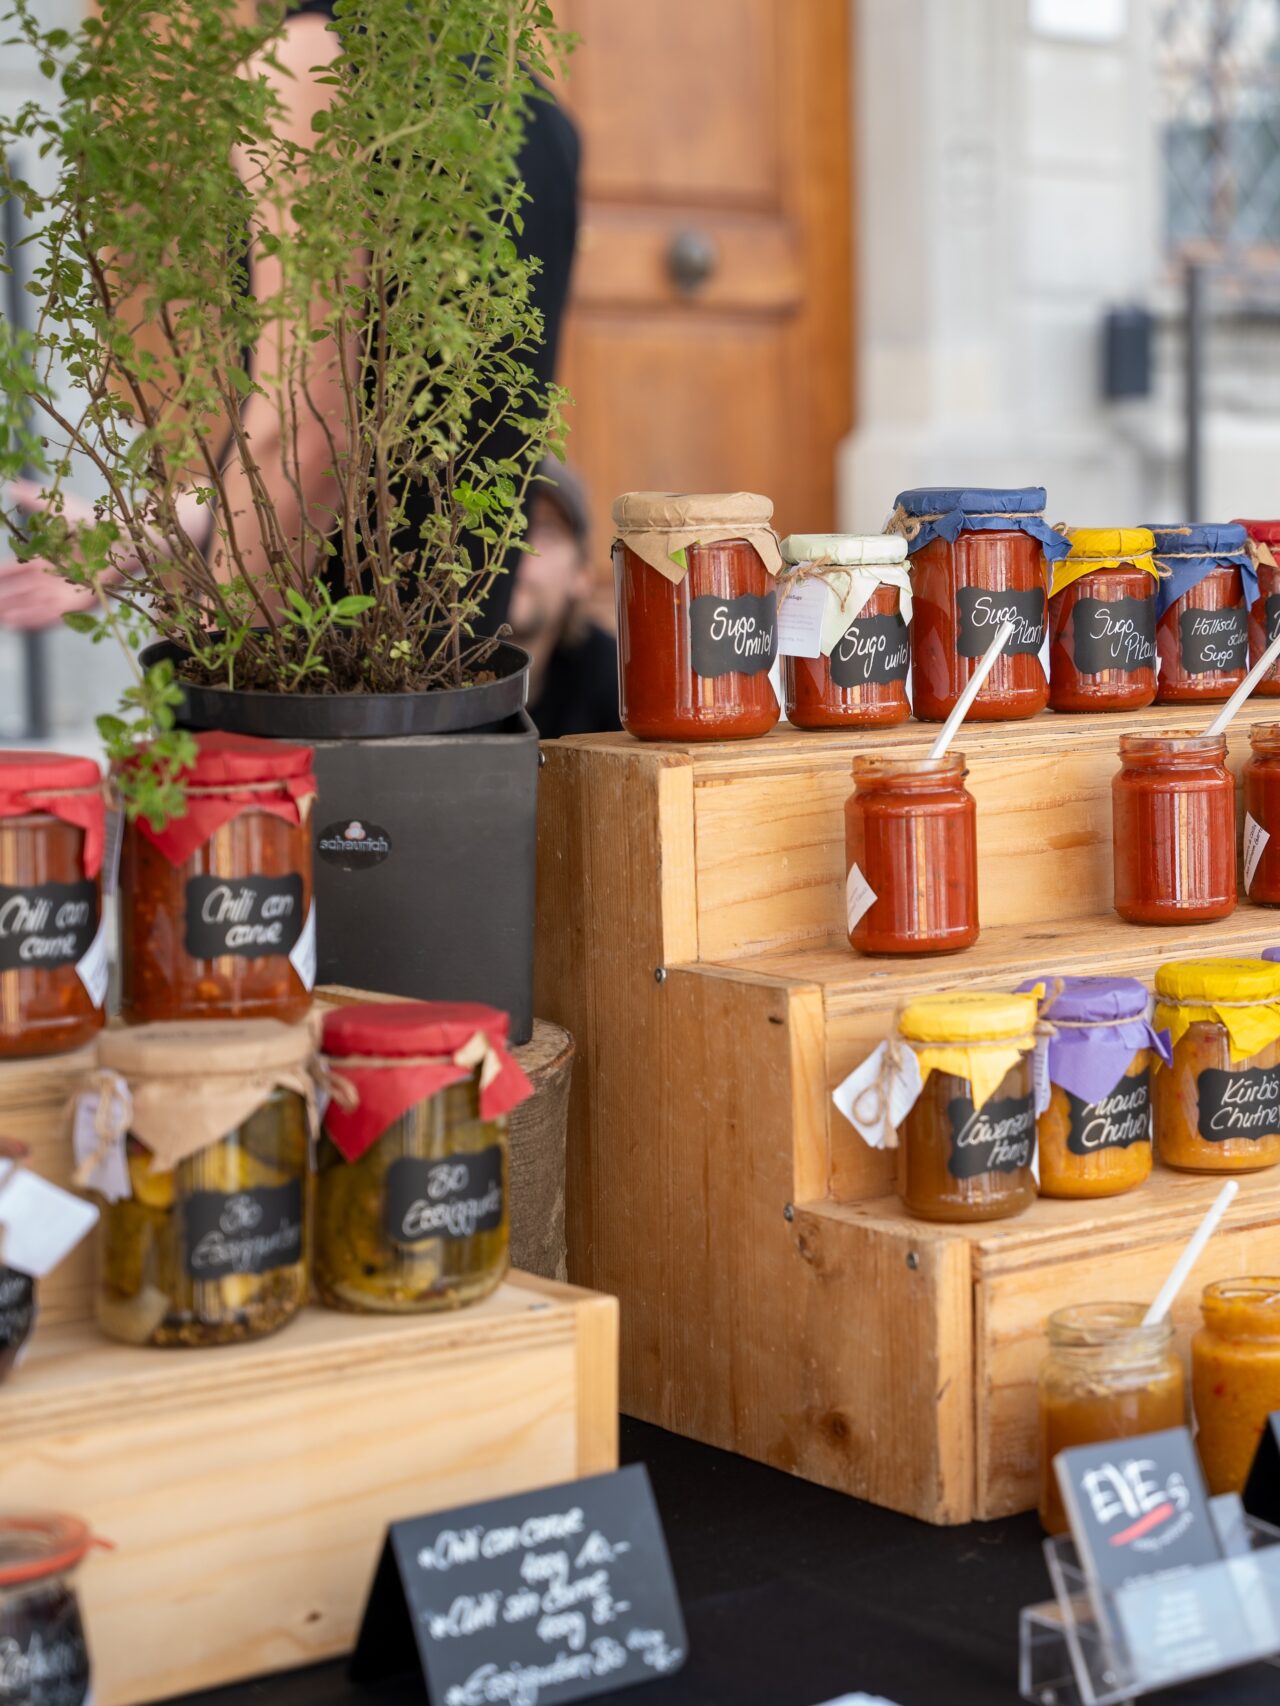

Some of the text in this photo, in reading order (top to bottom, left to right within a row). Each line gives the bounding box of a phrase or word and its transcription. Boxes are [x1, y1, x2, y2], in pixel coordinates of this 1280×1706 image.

[710, 606, 756, 654] Sugo
[839, 626, 886, 679] Sugo
[1089, 608, 1133, 658] Sugo
[1199, 643, 1235, 669] Sugo
[1220, 1073, 1280, 1106] Kürbis
